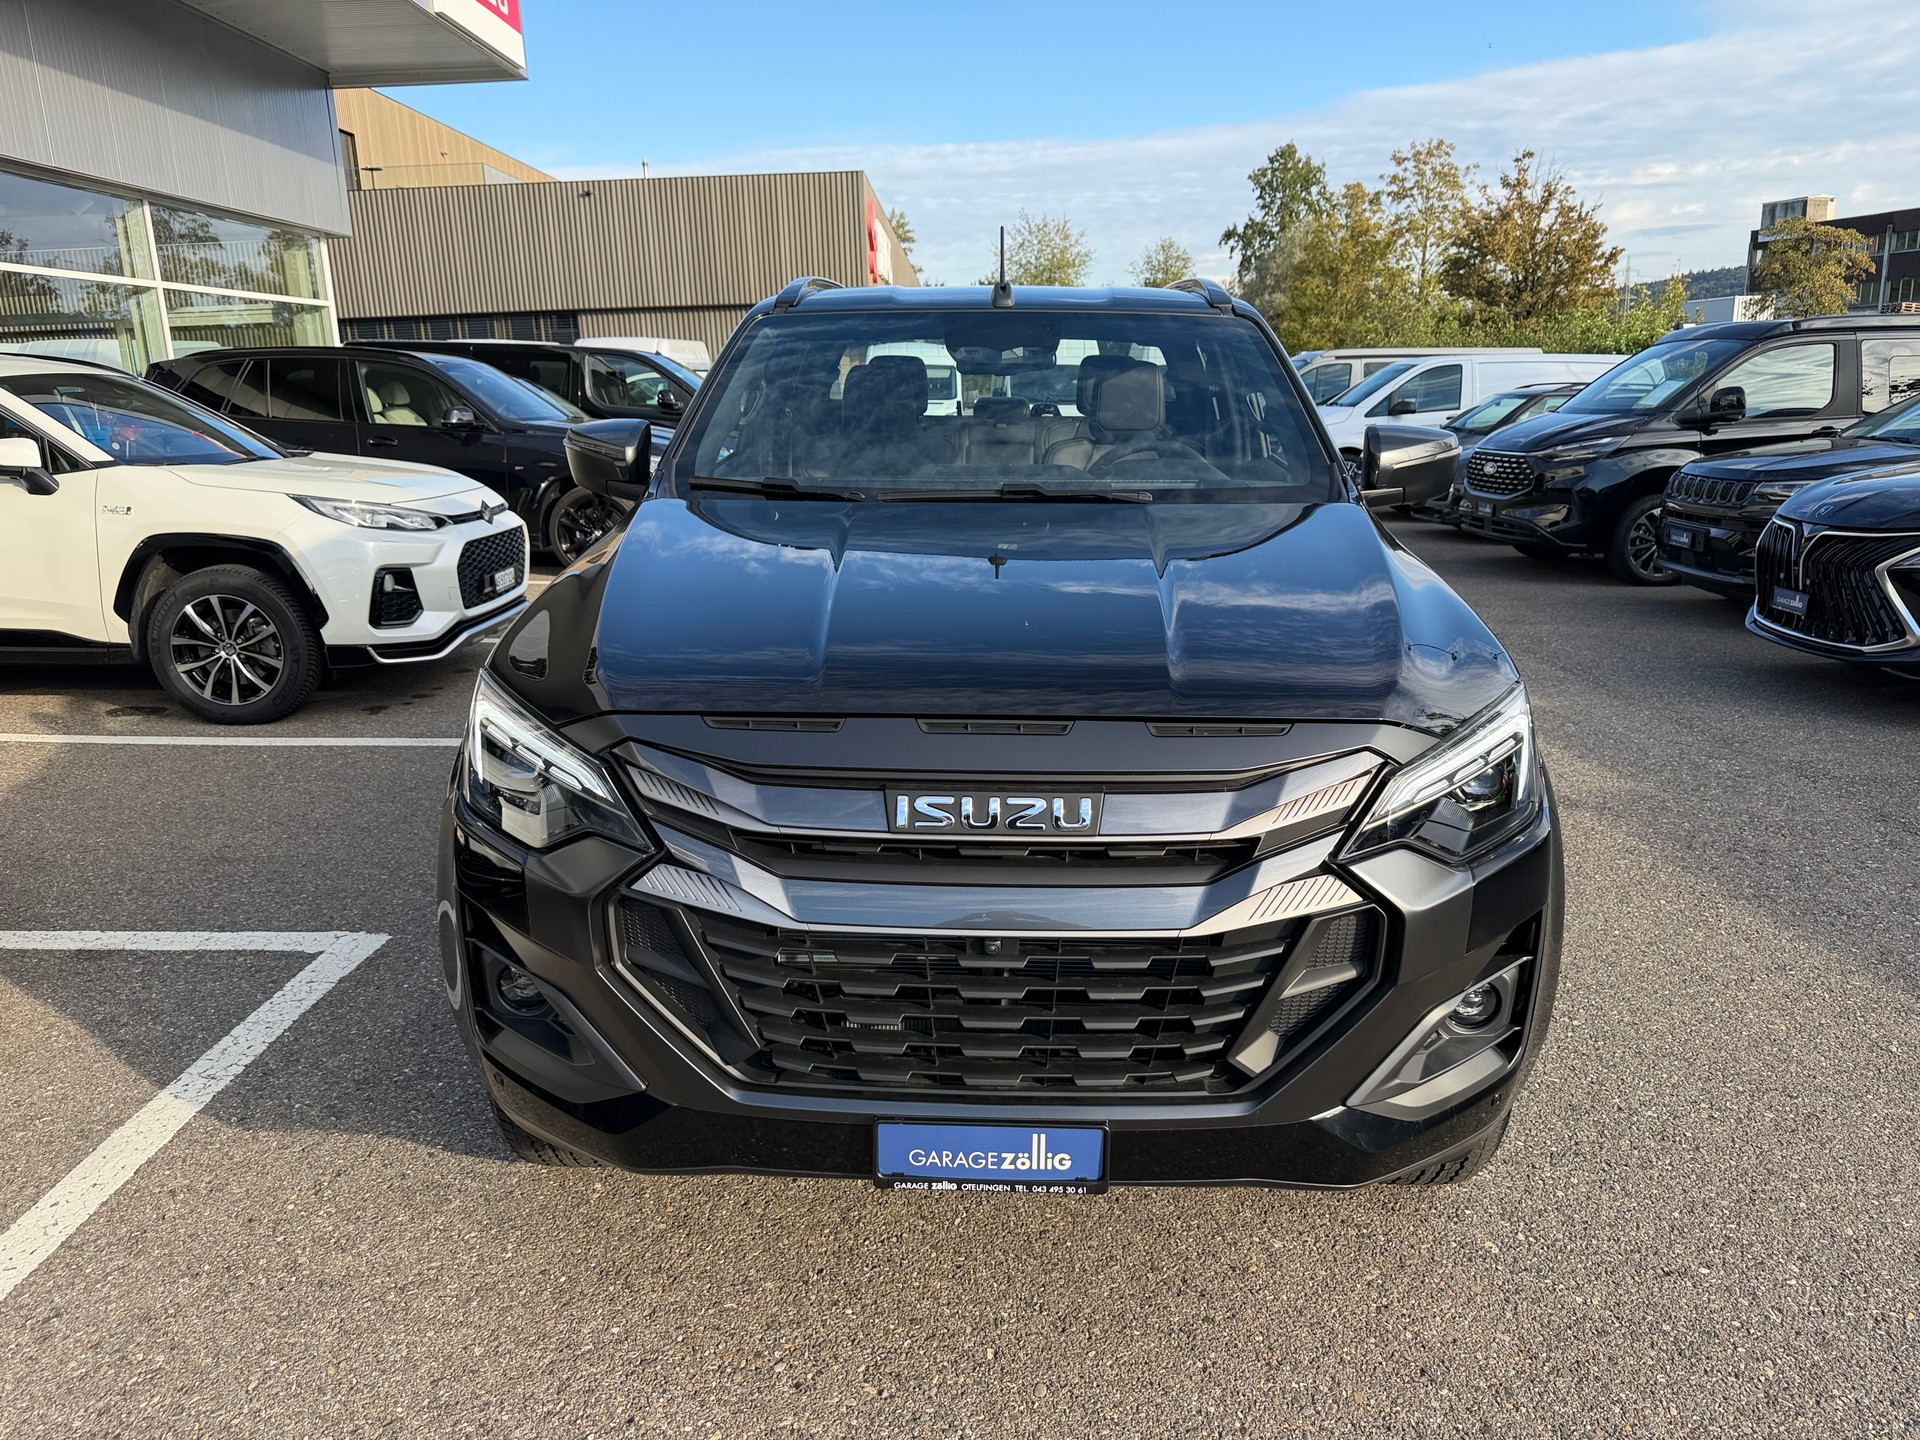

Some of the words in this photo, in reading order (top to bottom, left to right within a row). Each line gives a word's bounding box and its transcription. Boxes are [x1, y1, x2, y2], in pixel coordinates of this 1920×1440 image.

[896, 795, 1092, 830] ISUZU
[908, 1149, 998, 1169] GARAGE
[893, 1182, 929, 1190] GARAGE
[961, 1183, 1011, 1192] OTELFINGEN
[1032, 1185, 1047, 1193] 043
[1065, 1186, 1076, 1194] 30
[1077, 1186, 1087, 1194] 61
